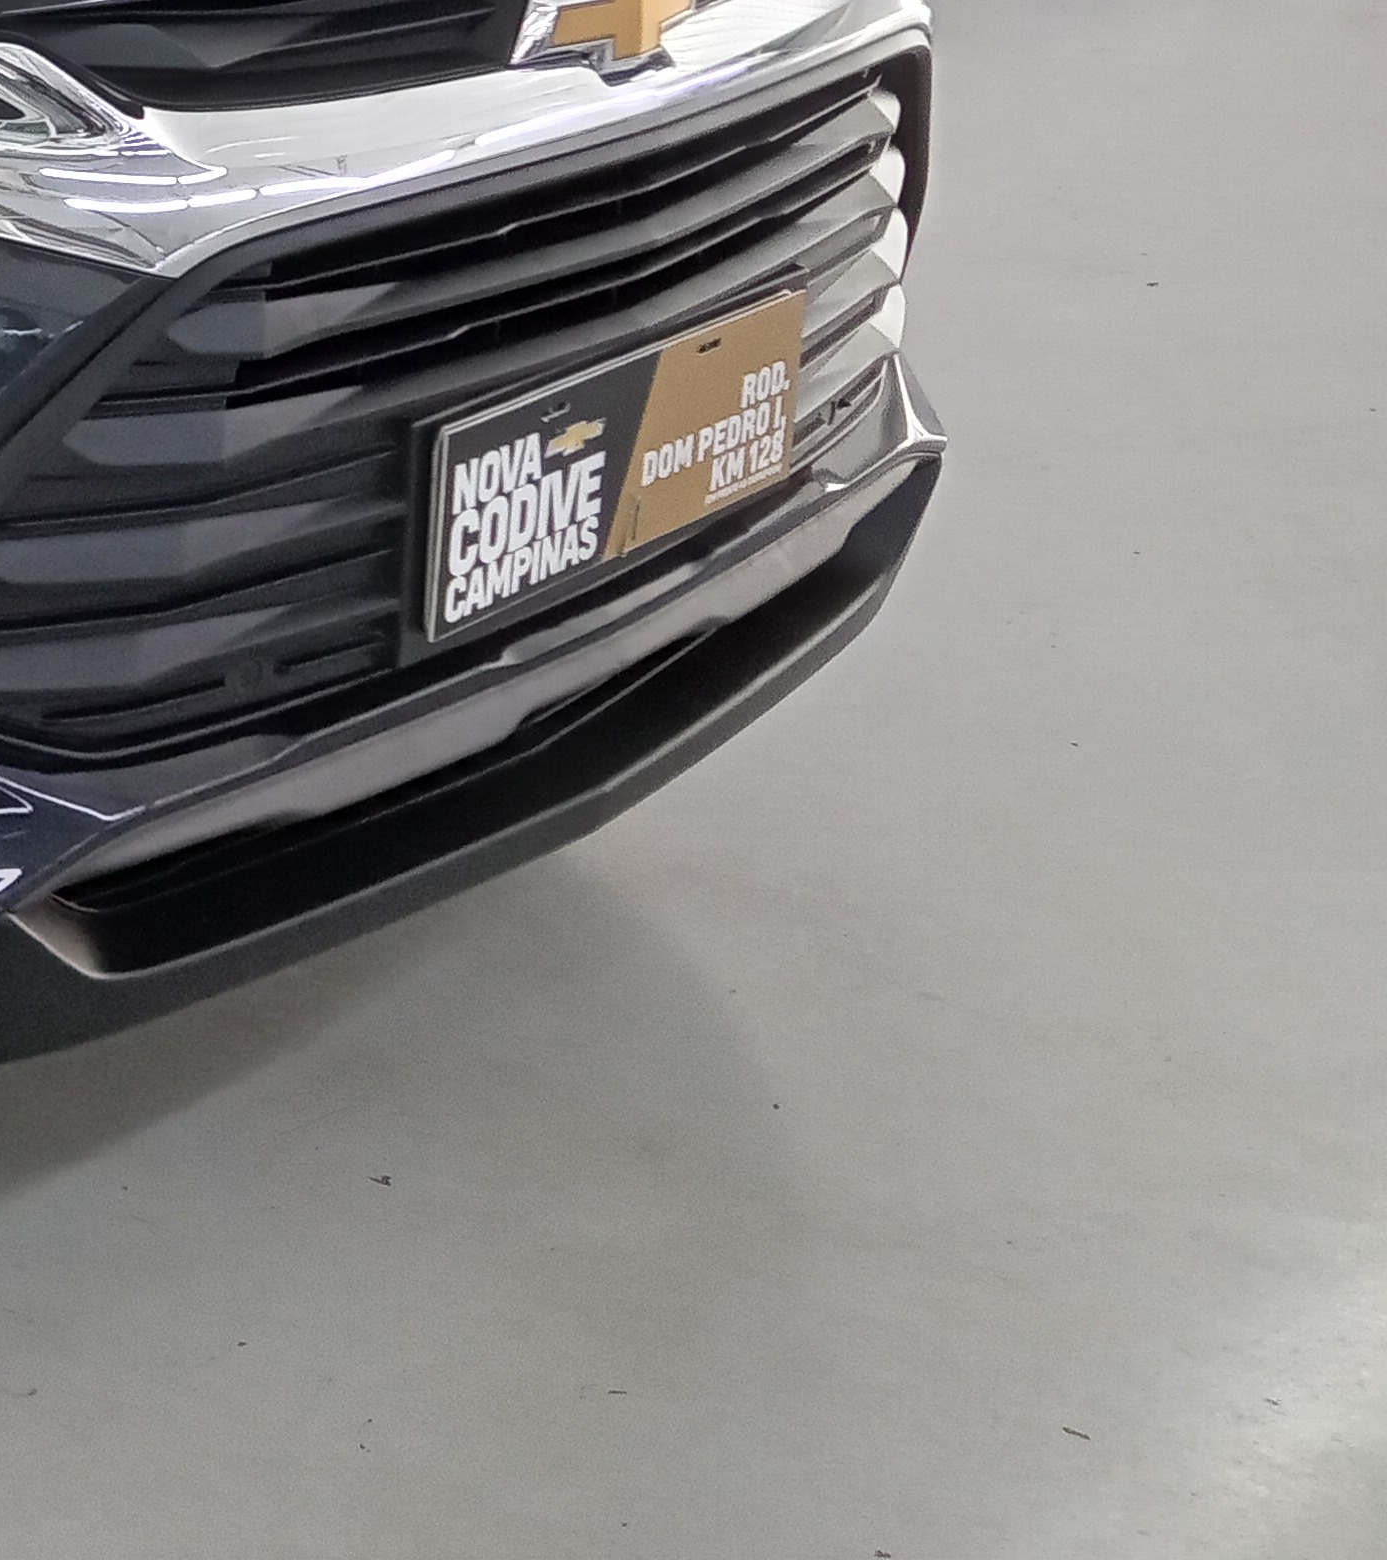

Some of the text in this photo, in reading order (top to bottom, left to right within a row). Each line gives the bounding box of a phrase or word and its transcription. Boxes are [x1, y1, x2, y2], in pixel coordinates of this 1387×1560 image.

[452, 432, 542, 515] NOVA
[641, 433, 695, 487] DOM
[696, 401, 771, 462] PEDRO
[709, 446, 746, 492] KM
[748, 429, 785, 474] 128
[448, 450, 607, 577] CODIVE
[444, 515, 600, 624] CAMPINAS
